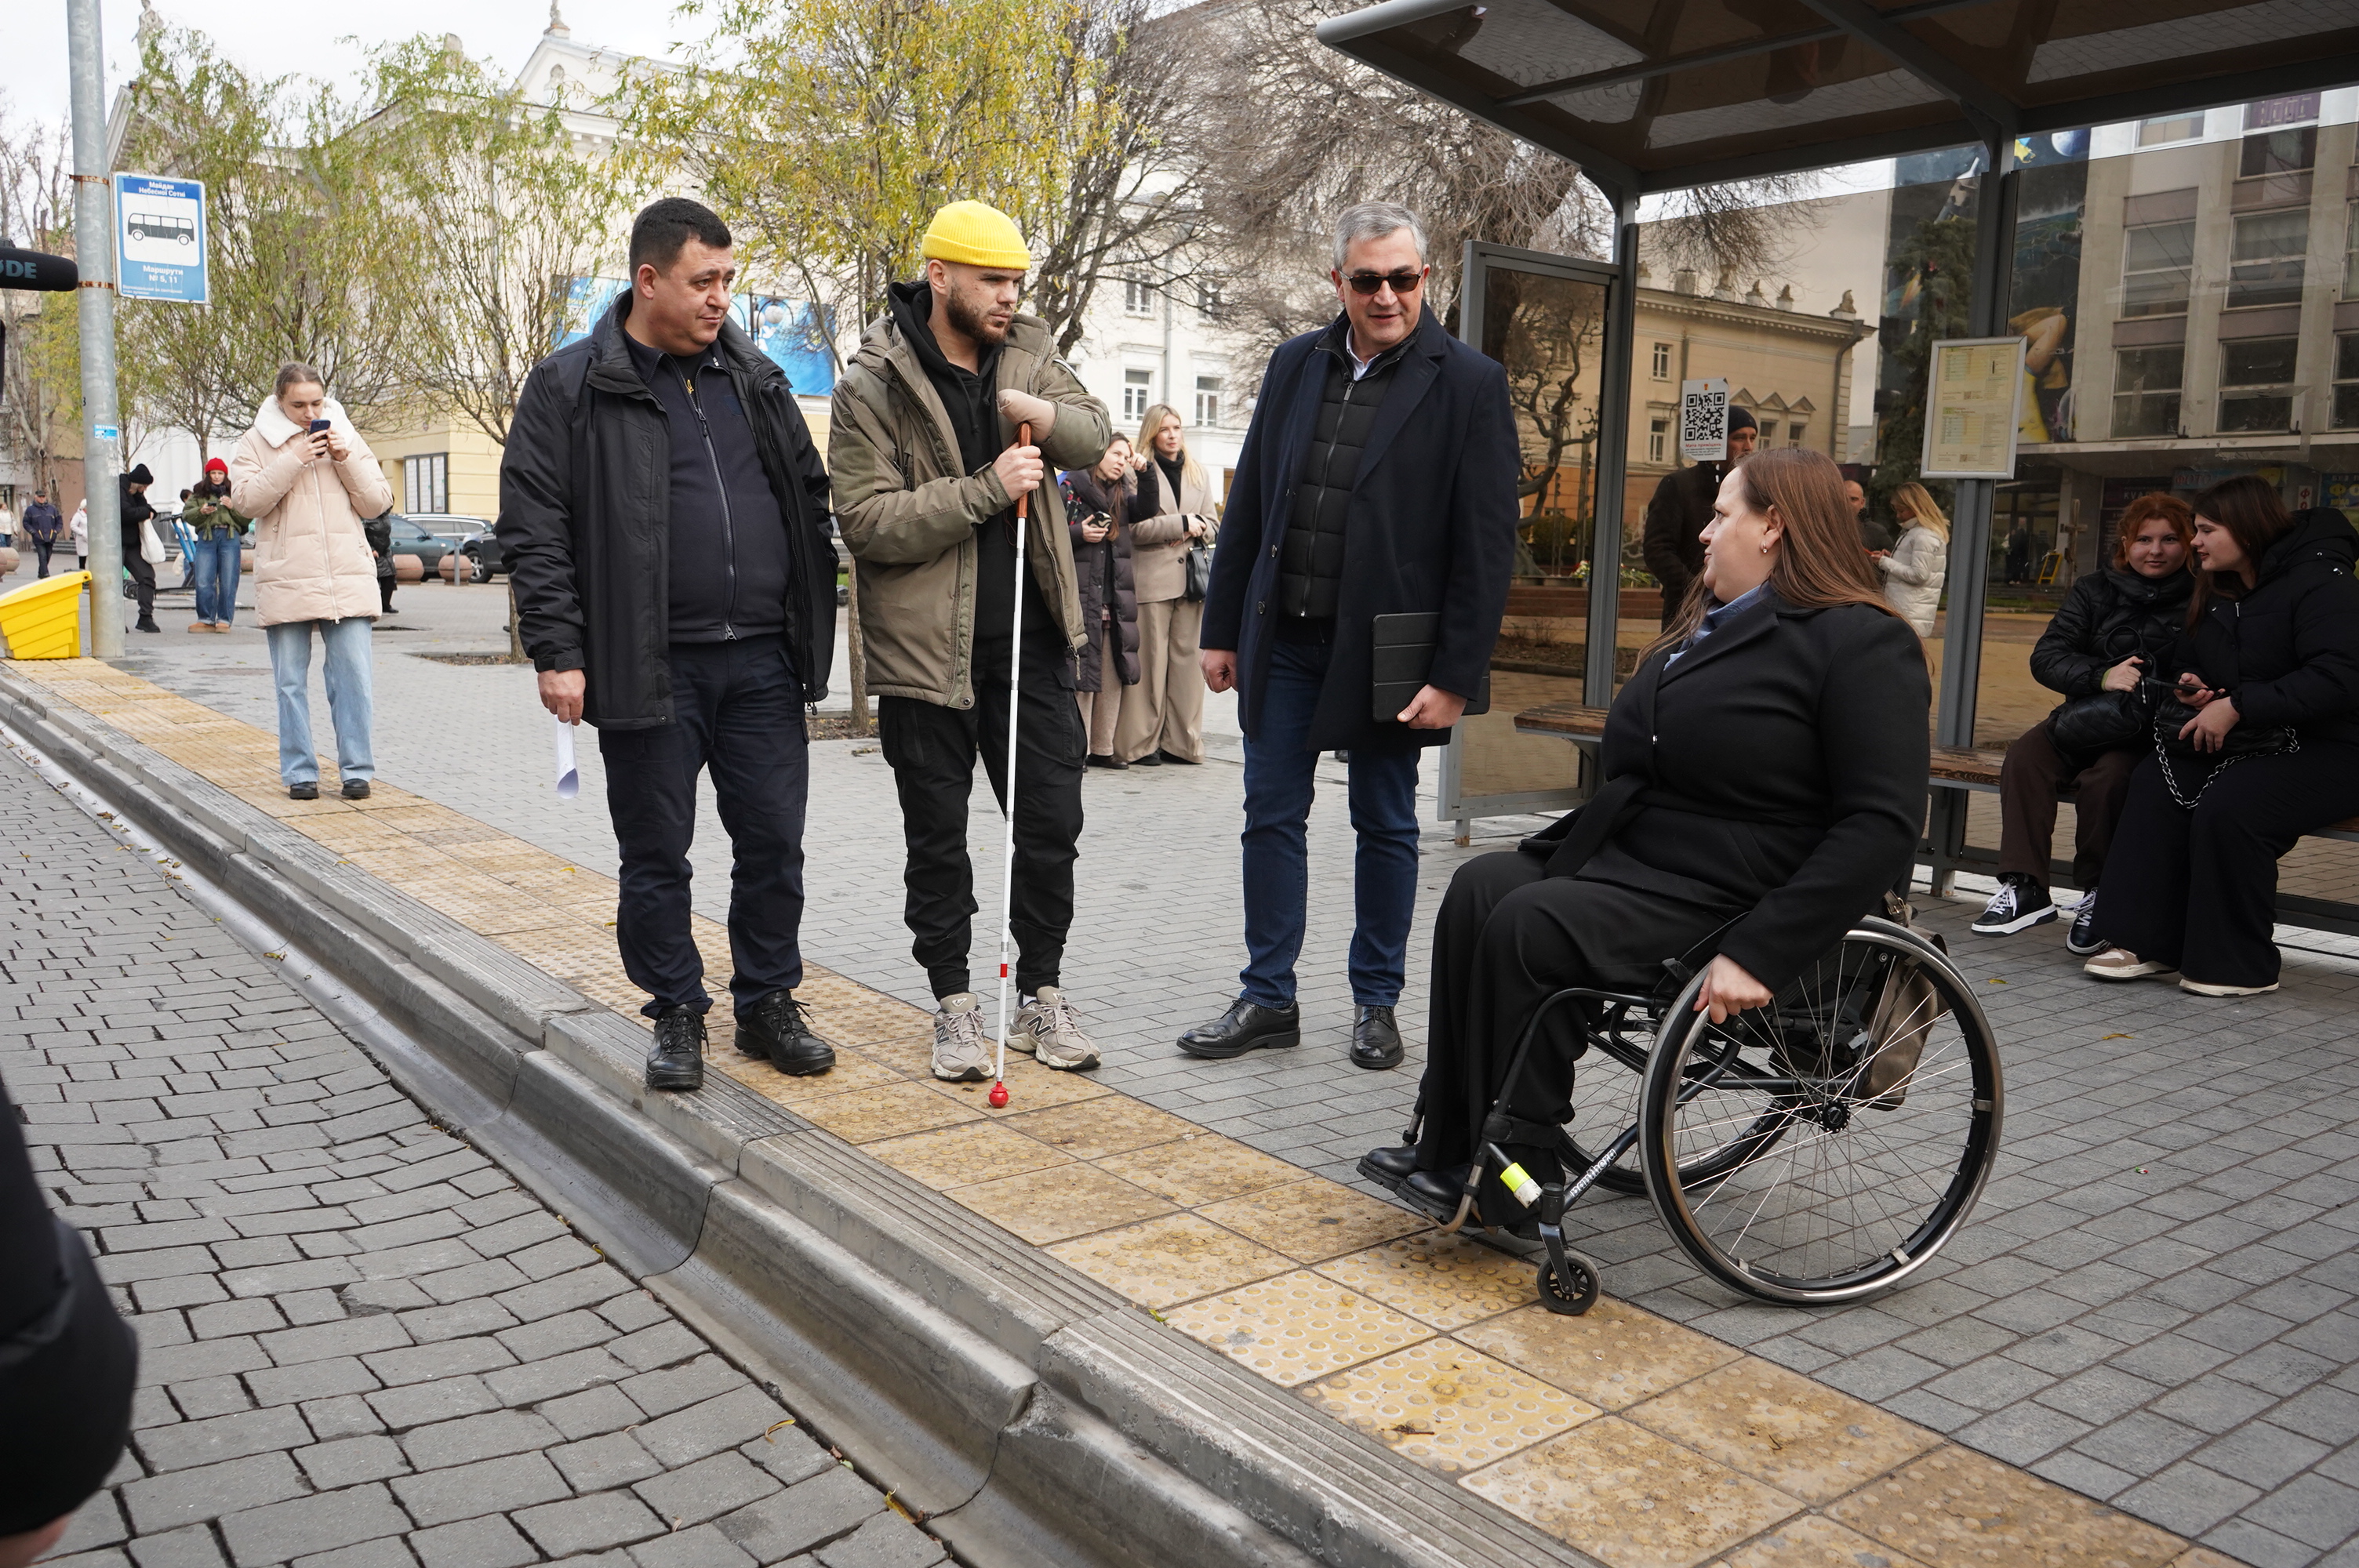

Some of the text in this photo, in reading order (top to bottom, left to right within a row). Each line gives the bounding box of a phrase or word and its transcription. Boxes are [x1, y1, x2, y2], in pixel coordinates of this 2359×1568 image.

[149, 181, 174, 190] Майдан
[139, 187, 168, 196] Небесної
[143, 265, 184, 275] Маршрути
[1569, 1149, 1617, 1198] panthera
